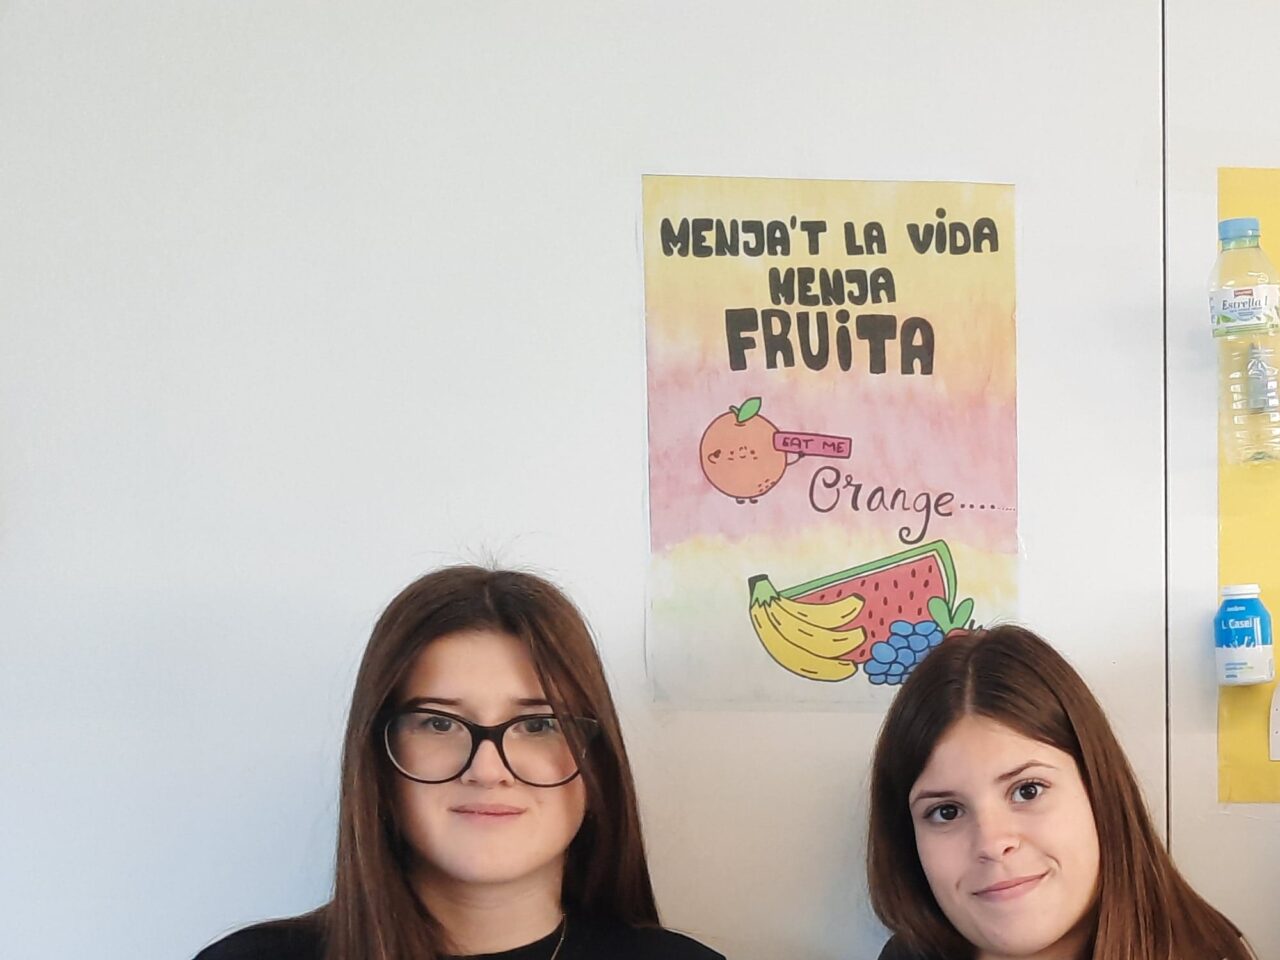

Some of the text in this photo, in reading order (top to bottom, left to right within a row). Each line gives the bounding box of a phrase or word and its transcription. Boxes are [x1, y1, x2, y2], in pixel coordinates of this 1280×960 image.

[660, 214, 828, 258] MENJA'T
[844, 221, 887, 256] LA
[768, 267, 897, 306] MENJA
[781, 436, 846, 453] EAT ME
